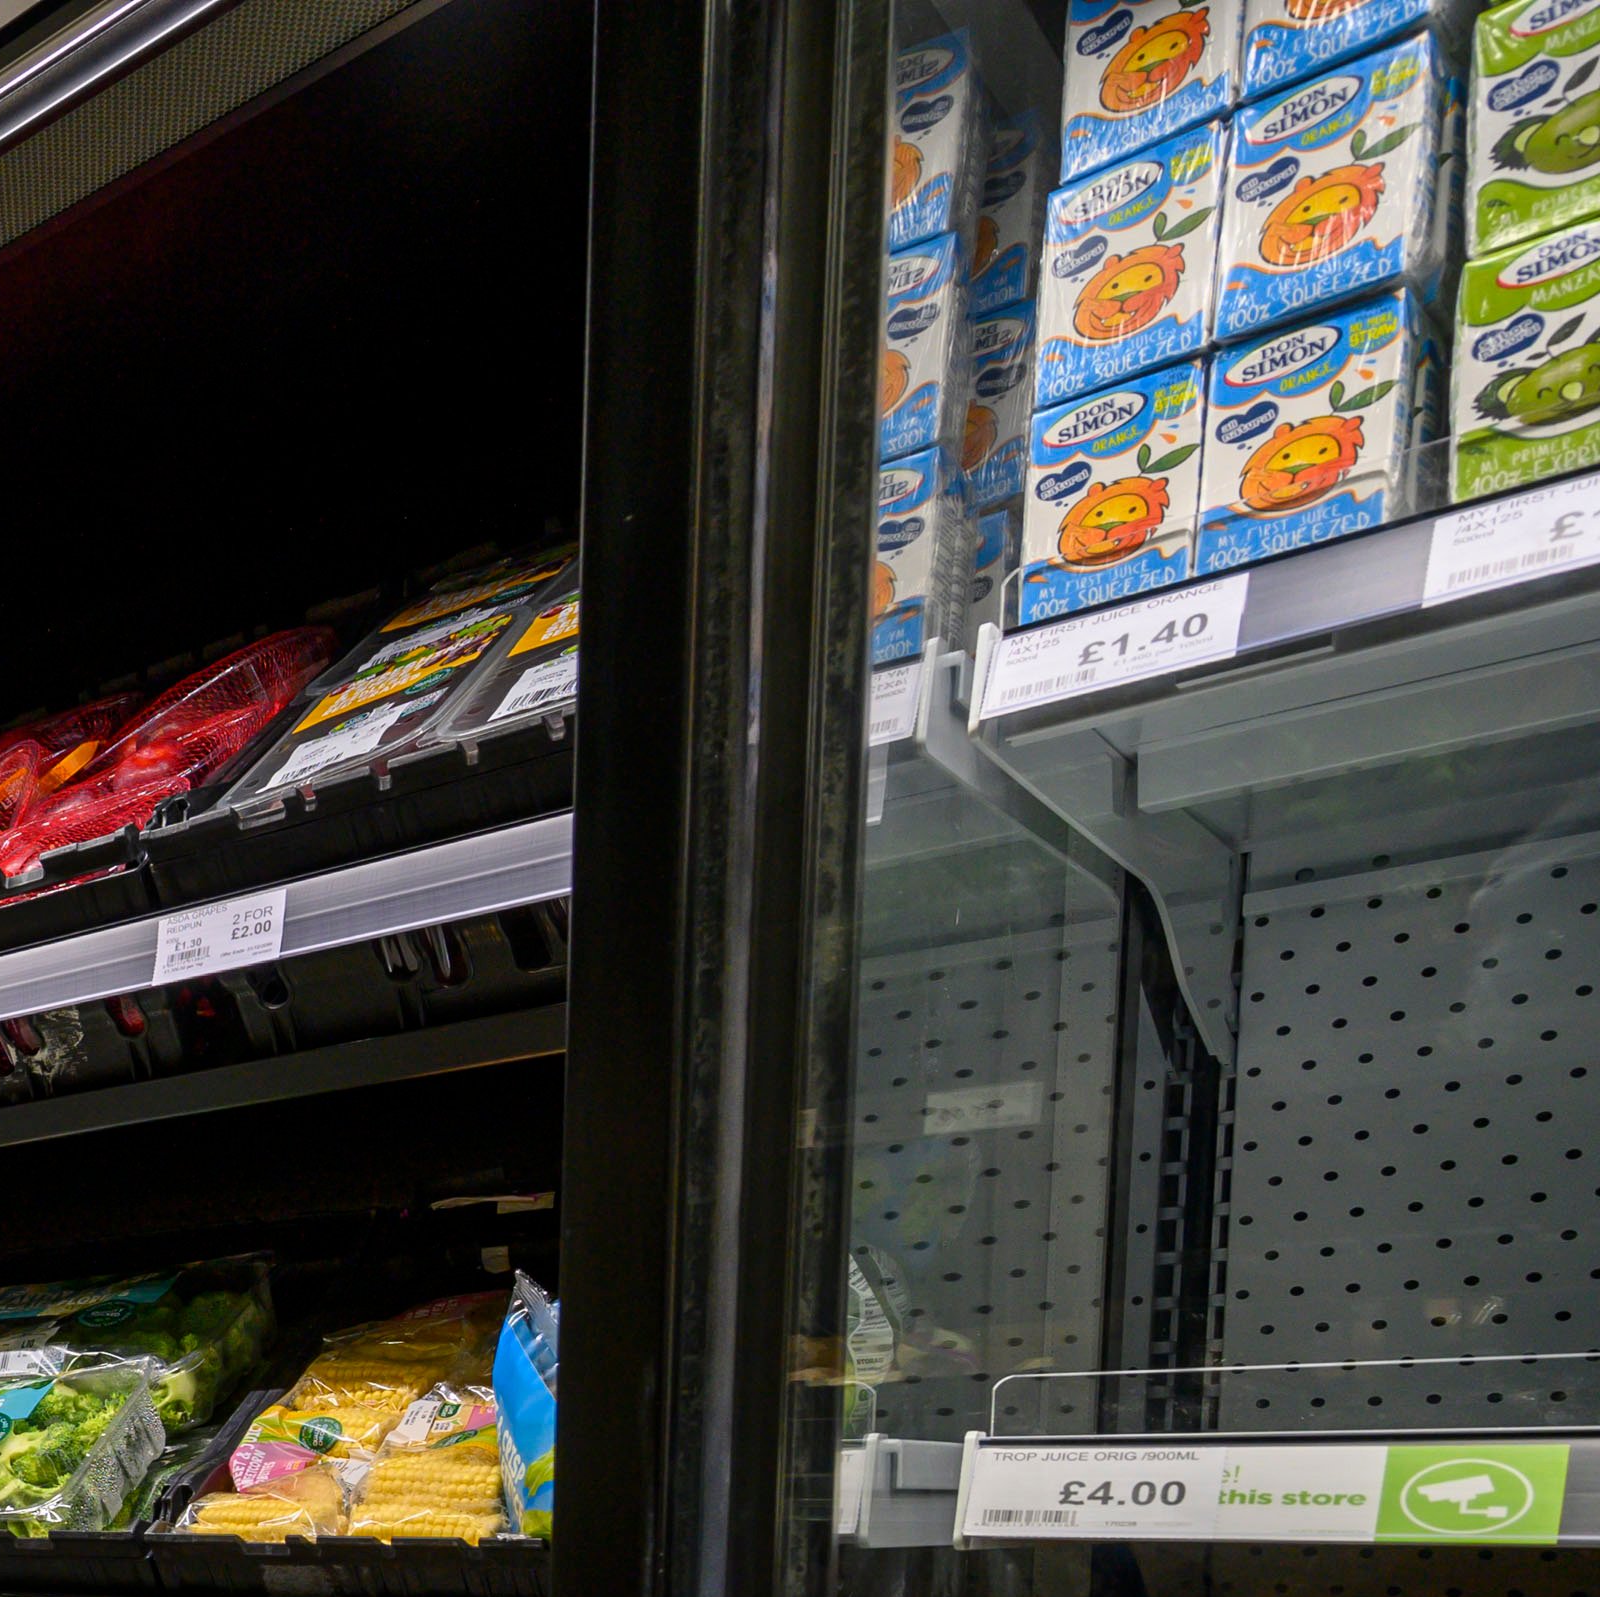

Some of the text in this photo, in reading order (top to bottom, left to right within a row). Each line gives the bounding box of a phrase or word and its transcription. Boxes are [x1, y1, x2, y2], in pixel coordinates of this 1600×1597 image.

[1241, 338, 1328, 383] SIMON
[1259, 334, 1308, 361] DON
[1279, 366, 1332, 392] ORANGE
[1075, 399, 1115, 422] DON
[1058, 403, 1135, 445] SIMON
[1092, 428, 1139, 453] ORANGE
[1248, 519, 1290, 539] FIRST
[1301, 504, 1340, 527] JUICE
[1254, 511, 1371, 560] SQUEEZED
[1065, 573, 1099, 593] FIRST
[1111, 560, 1150, 581] JUICE
[1078, 566, 1176, 608] SQUEEZED
[1010, 581, 1224, 646] MY FIRST JUICE ORANGE
[1007, 637, 1060, 657] /4X125
[1078, 612, 1208, 666] £1.40
[233, 906, 273, 925] 2 FOR
[232, 920, 272, 940] £2.00
[993, 1452, 1200, 1462] TROP JUICE ORIG /900ML
[1058, 1480, 1186, 1506] £4.00
[1281, 1490, 1367, 1506] store
